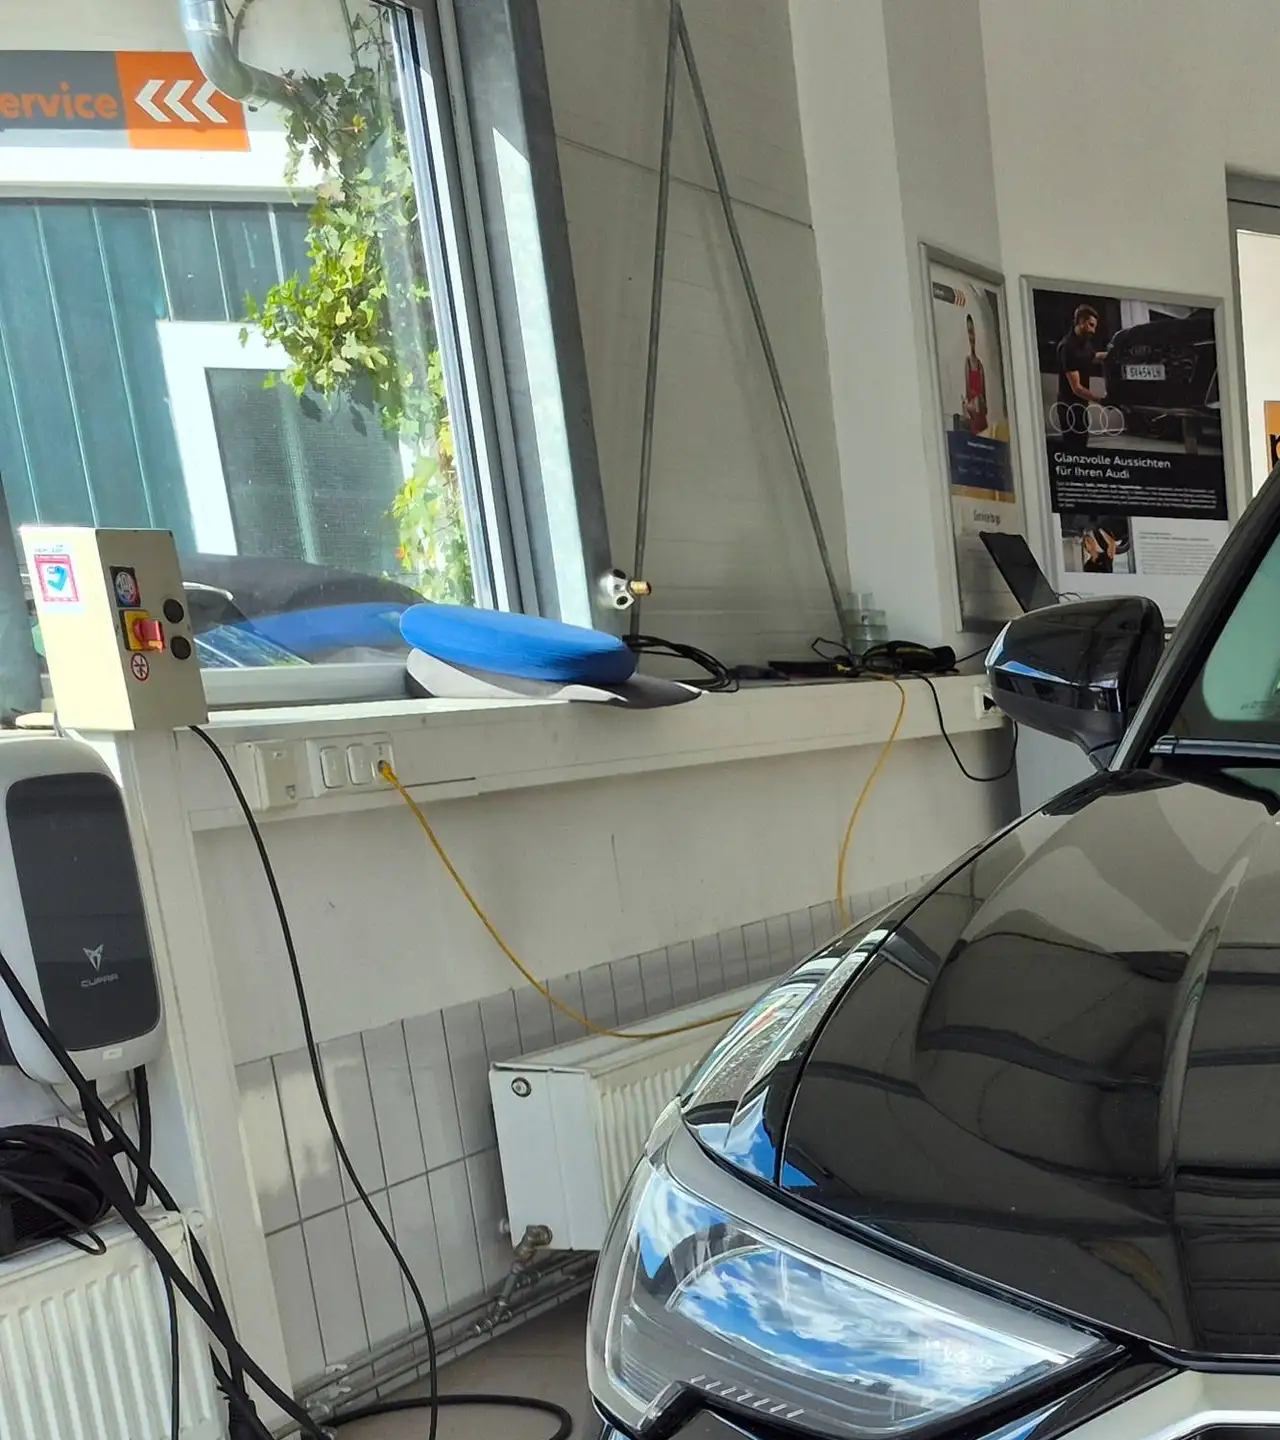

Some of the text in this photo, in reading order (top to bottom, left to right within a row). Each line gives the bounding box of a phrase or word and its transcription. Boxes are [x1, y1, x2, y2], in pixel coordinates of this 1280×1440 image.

[0, 81, 118, 120] ervice
[1053, 452, 1172, 469] Glanzvolle Aussichten
[1056, 466, 1131, 479] für Ihren Audi
